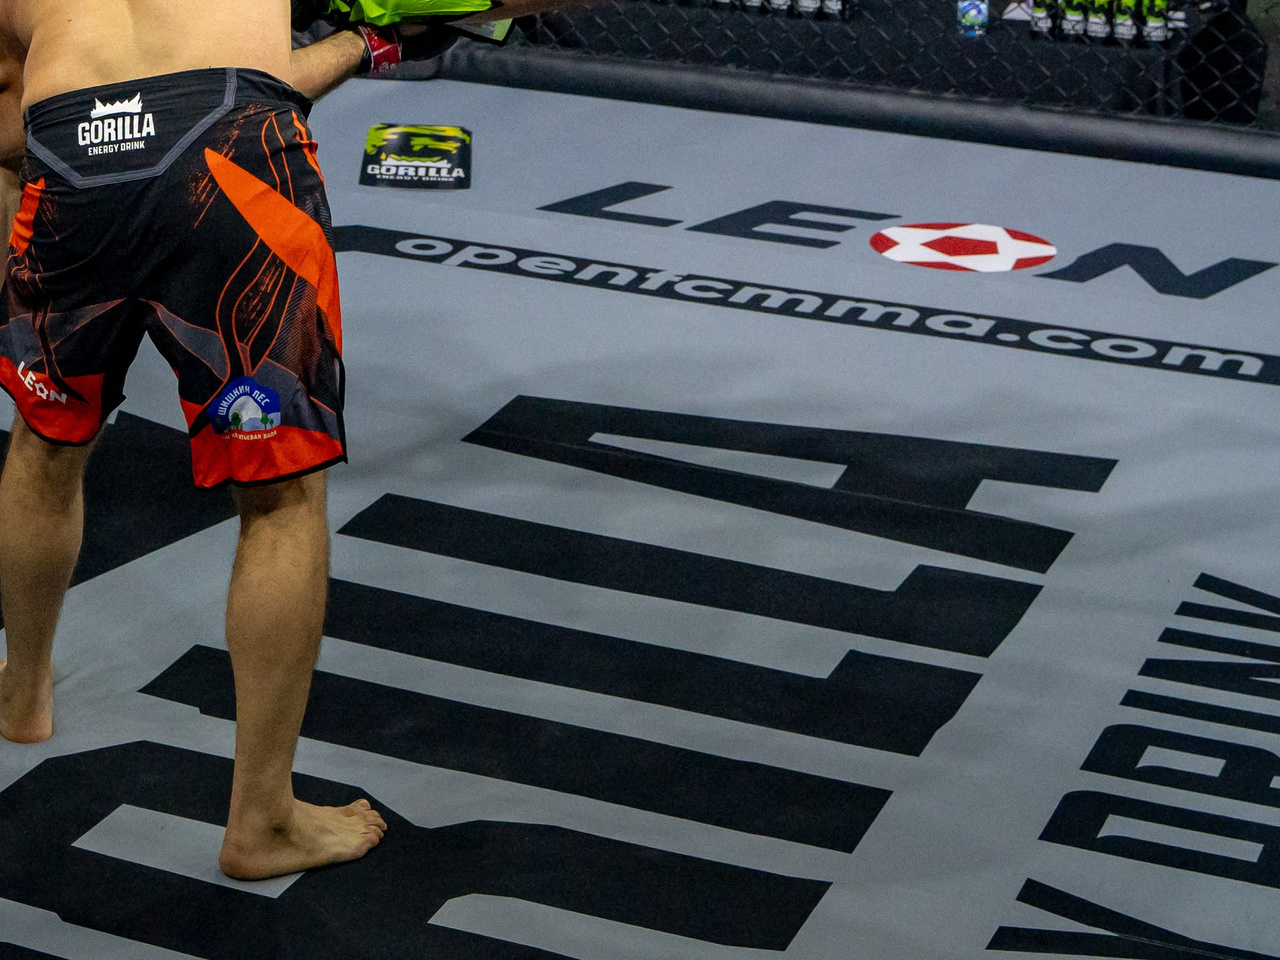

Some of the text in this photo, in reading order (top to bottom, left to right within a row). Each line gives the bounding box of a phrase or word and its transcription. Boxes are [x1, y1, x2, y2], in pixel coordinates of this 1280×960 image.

[77, 113, 156, 146] GORILLA
[88, 140, 146, 156] ENERGY DRINK
[366, 164, 466, 178] GORILLA
[536, 180, 1279, 299] LEON
[17, 360, 68, 404] LEON
[217, 385, 271, 416] ШИШКИН ЛЕС
